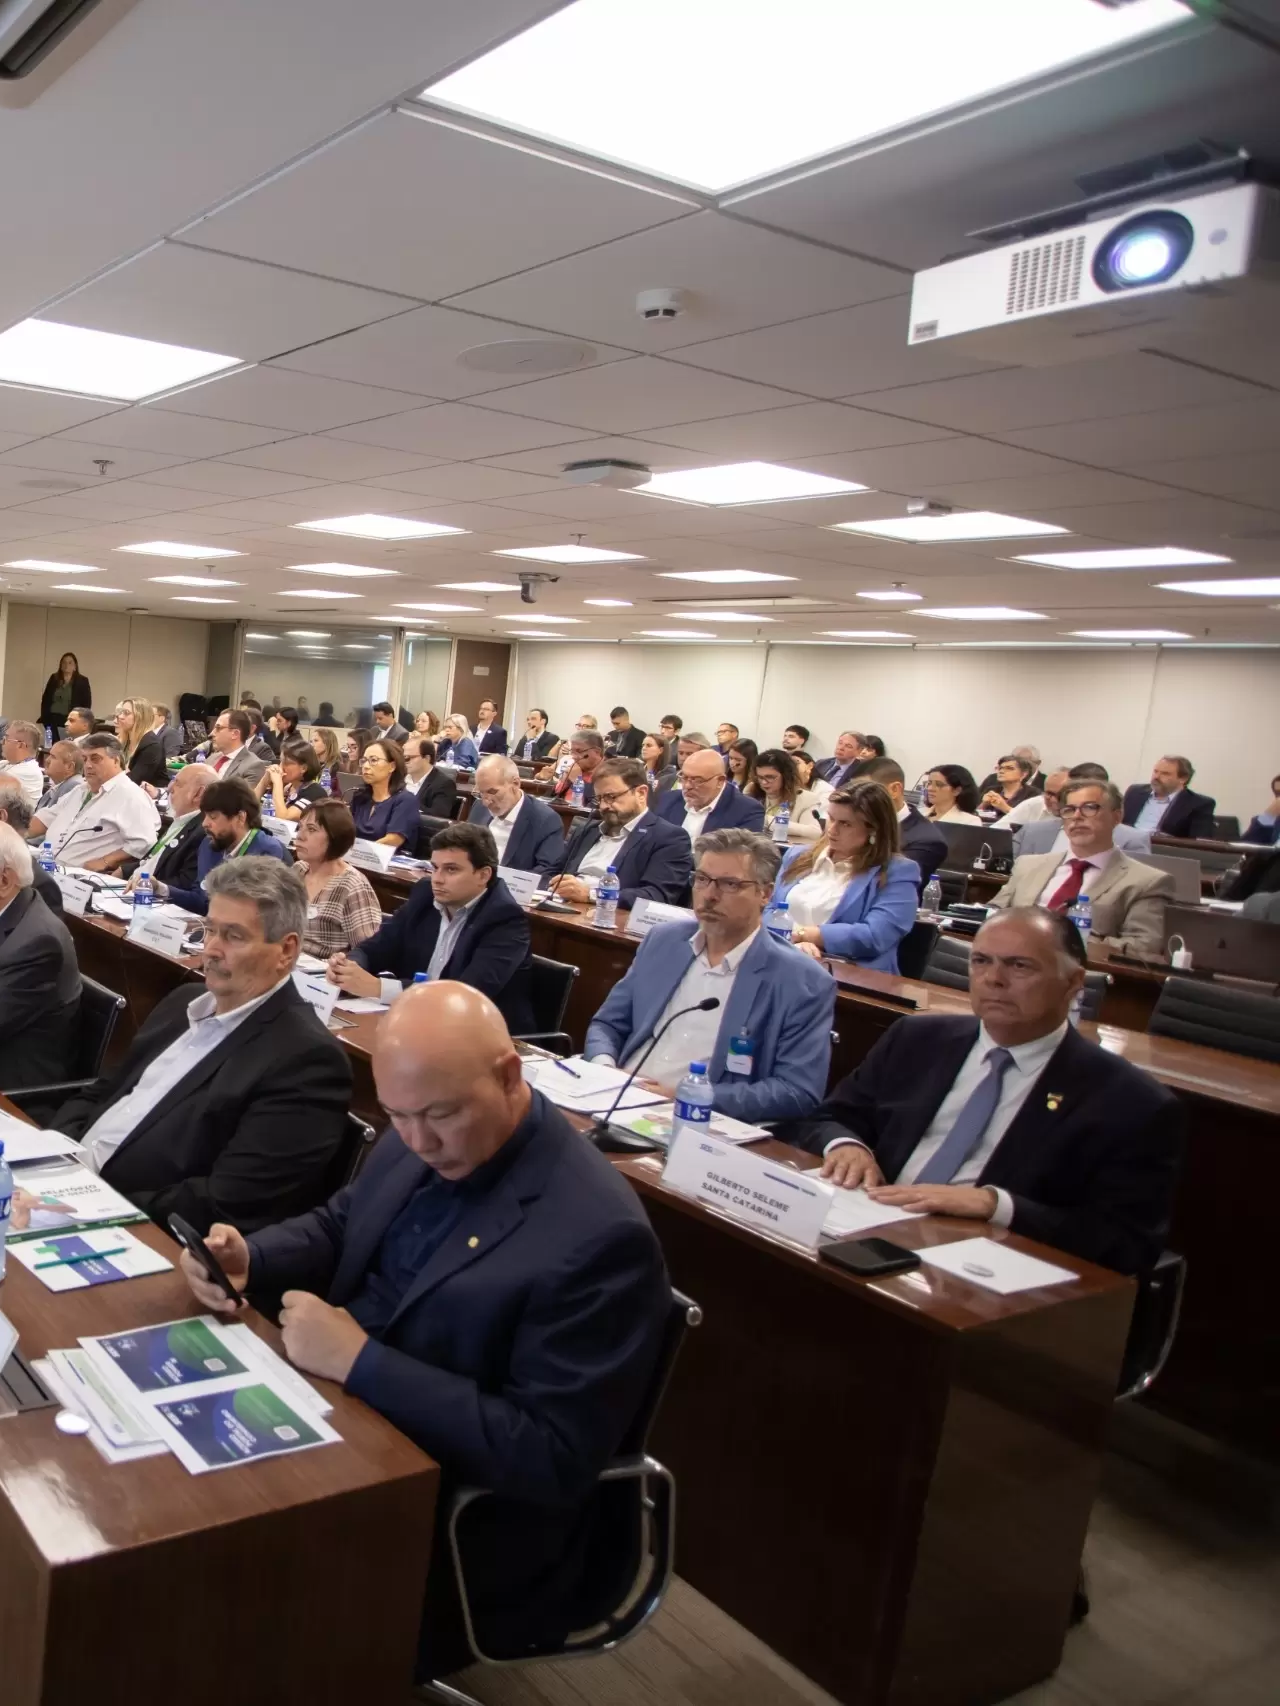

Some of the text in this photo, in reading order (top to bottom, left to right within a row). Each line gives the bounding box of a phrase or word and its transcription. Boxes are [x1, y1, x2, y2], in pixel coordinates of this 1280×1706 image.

[701, 1182, 779, 1221] SANTA CATARINA
[706, 1171, 790, 1212] GILBERTO SELEME
